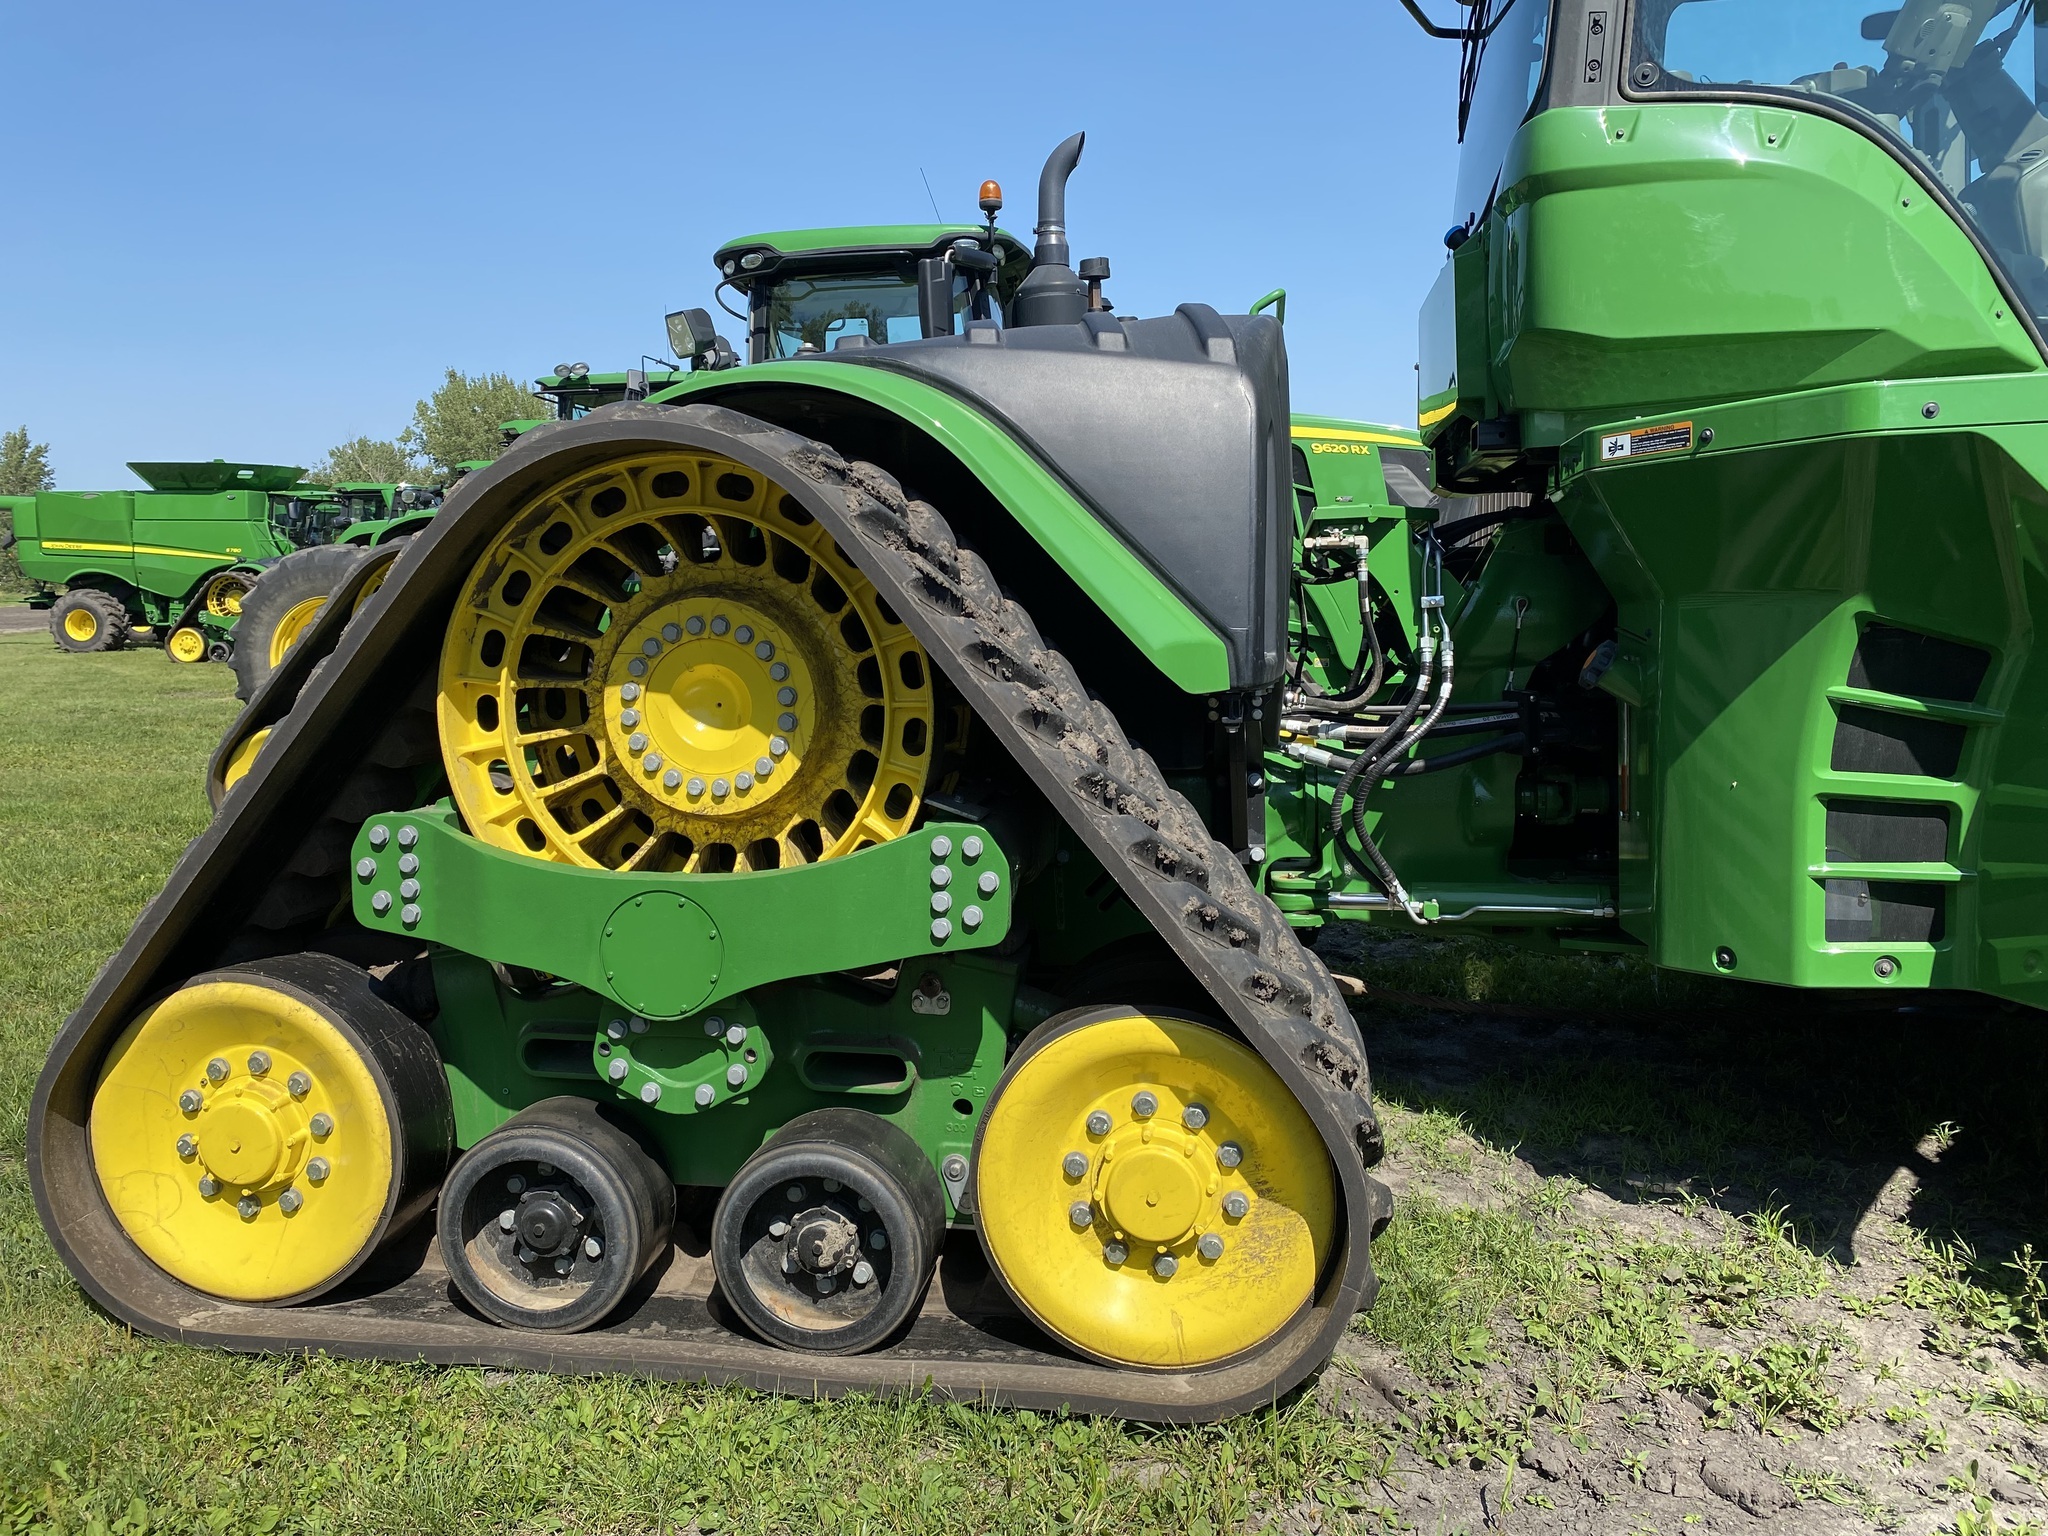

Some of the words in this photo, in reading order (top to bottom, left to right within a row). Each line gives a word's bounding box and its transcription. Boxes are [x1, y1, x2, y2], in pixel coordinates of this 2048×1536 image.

[1649, 424, 1675, 433] WARNING
[1310, 442, 1349, 454] 9620
[1351, 445, 1371, 455] RX
[946, 1122, 967, 1133] 300
